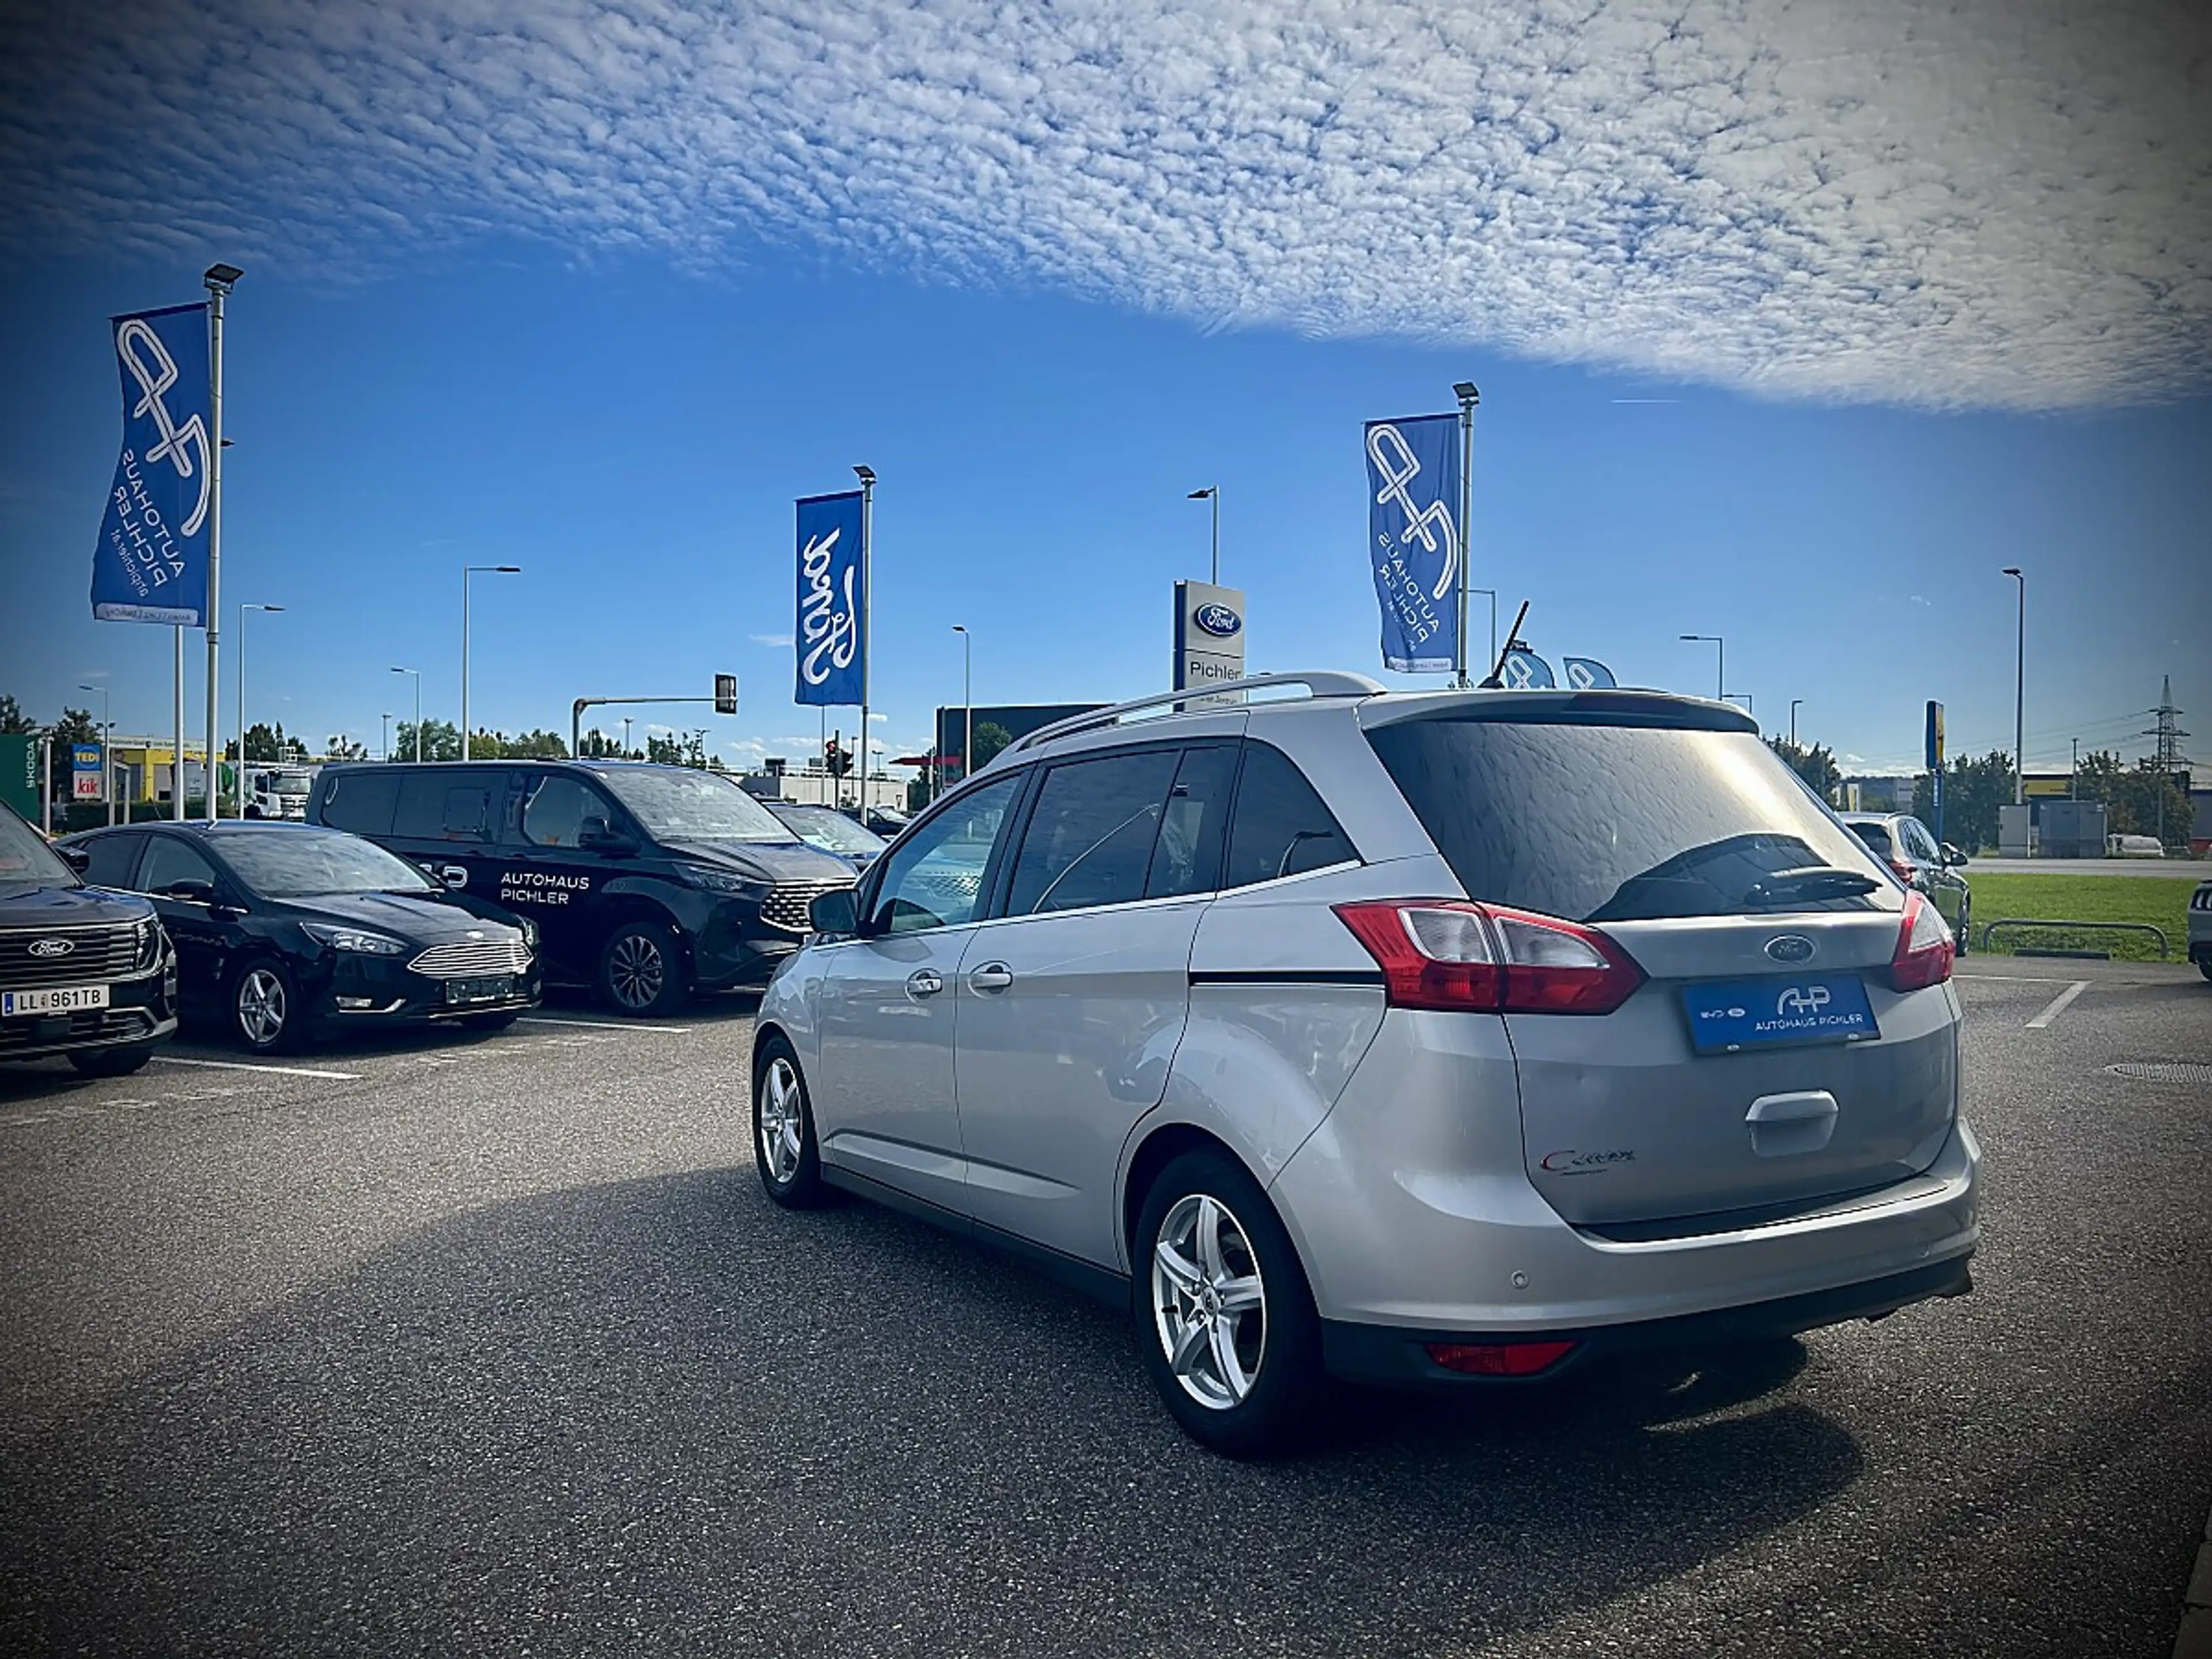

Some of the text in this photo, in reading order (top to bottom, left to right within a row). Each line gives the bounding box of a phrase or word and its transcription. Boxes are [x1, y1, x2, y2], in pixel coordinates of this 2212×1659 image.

[1190, 661, 1241, 681] Pichler
[501, 872, 589, 889] AUTOHAUS
[501, 888, 569, 904] PICHLER
[20, 989, 101, 1010] LL 961TB
[1755, 1013, 1863, 1032] AUTOHAUS PICHLER
